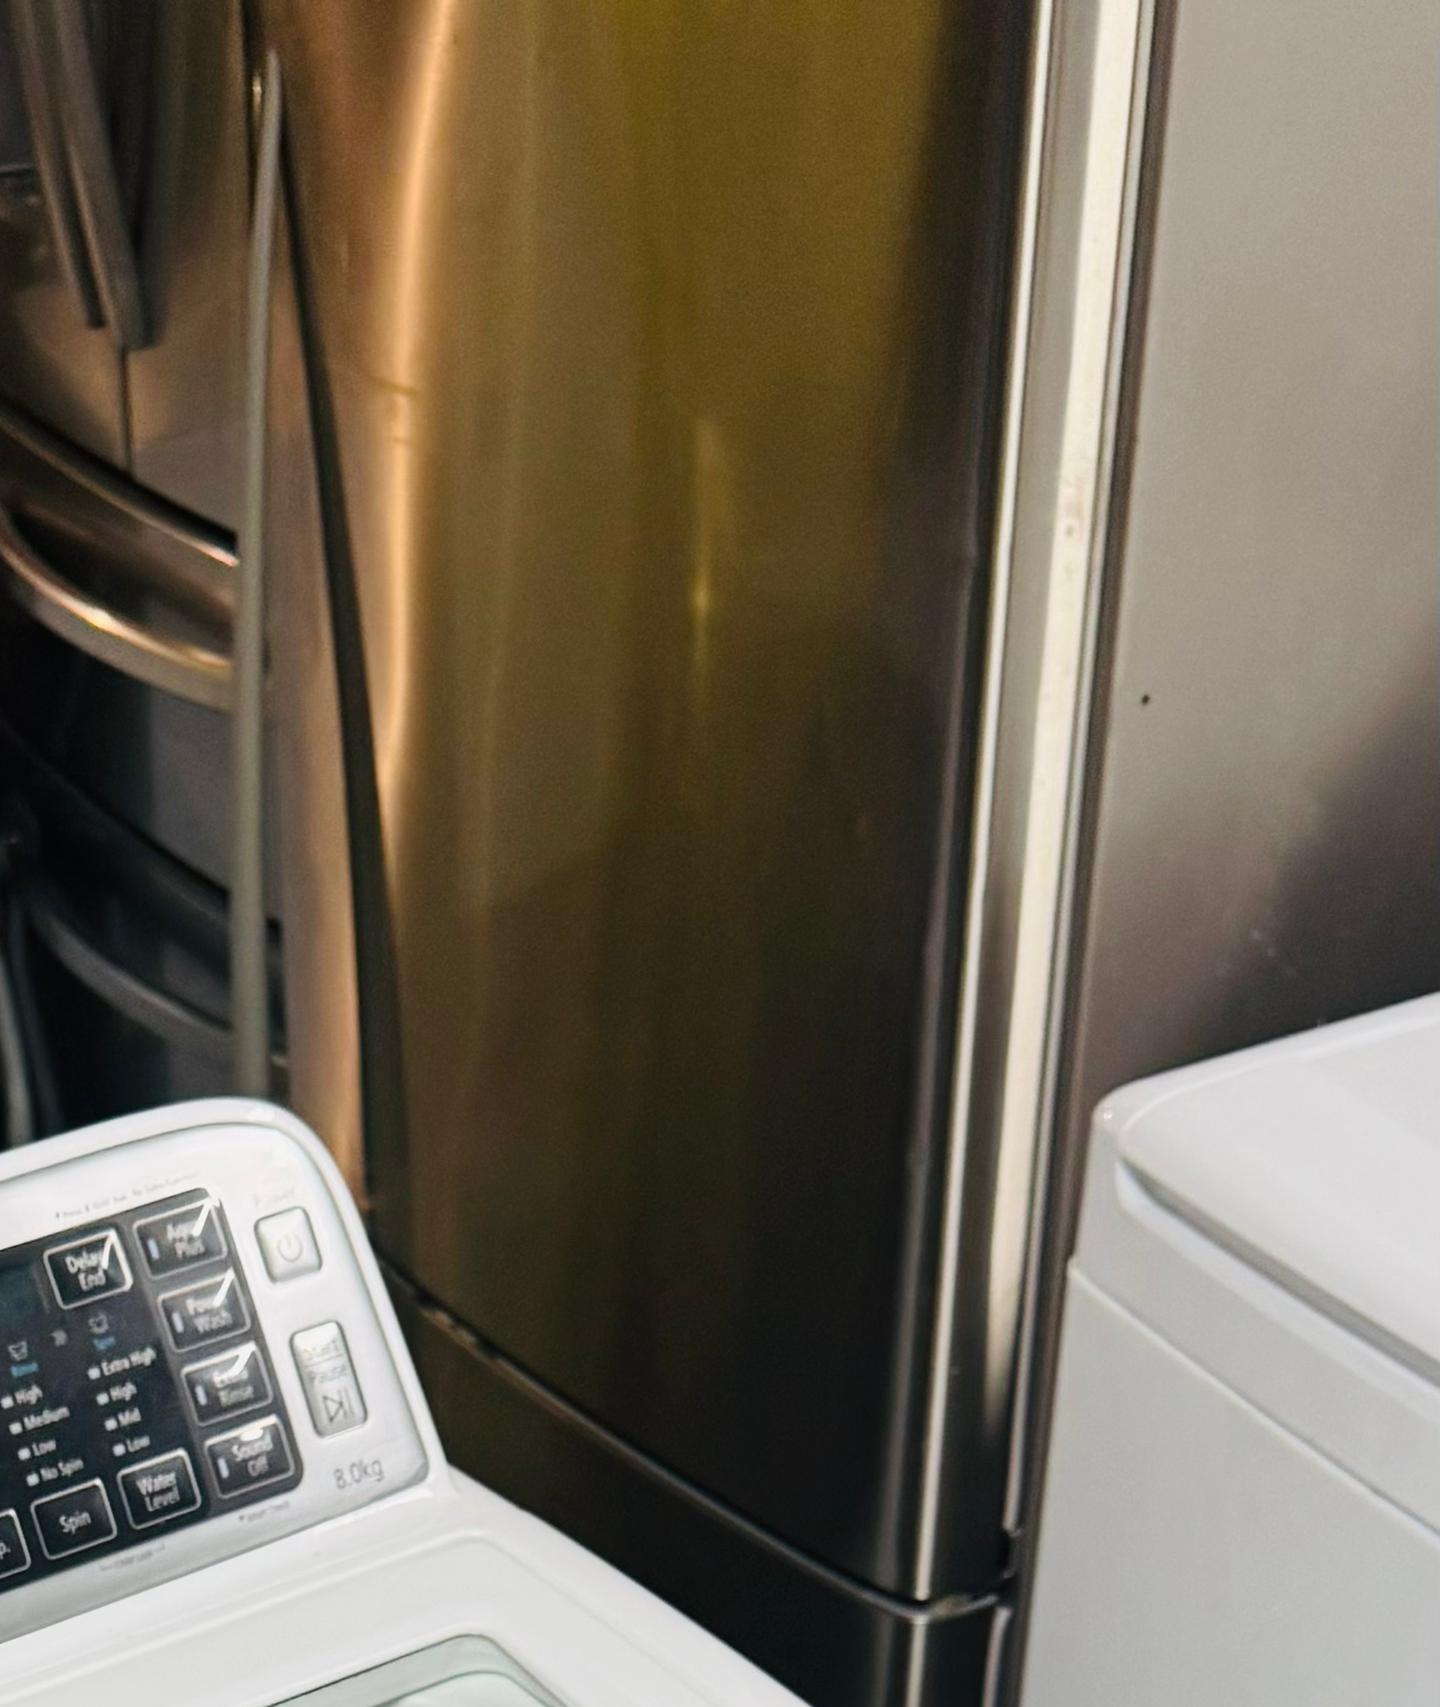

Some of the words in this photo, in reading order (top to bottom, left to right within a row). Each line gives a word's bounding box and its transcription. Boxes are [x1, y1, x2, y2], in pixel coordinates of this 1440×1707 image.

[78, 1268, 107, 1292] End
[14, 1383, 43, 1405] High
[109, 1381, 137, 1402] High
[23, 1406, 70, 1430] Medium
[117, 1407, 142, 1427] Mid
[32, 1439, 57, 1456] Low
[126, 1435, 151, 1452] Low
[135, 1471, 176, 1496] Water
[333, 1459, 384, 1490] 8.0kg
[144, 1487, 180, 1512] Level
[59, 1511, 91, 1535] Spin
